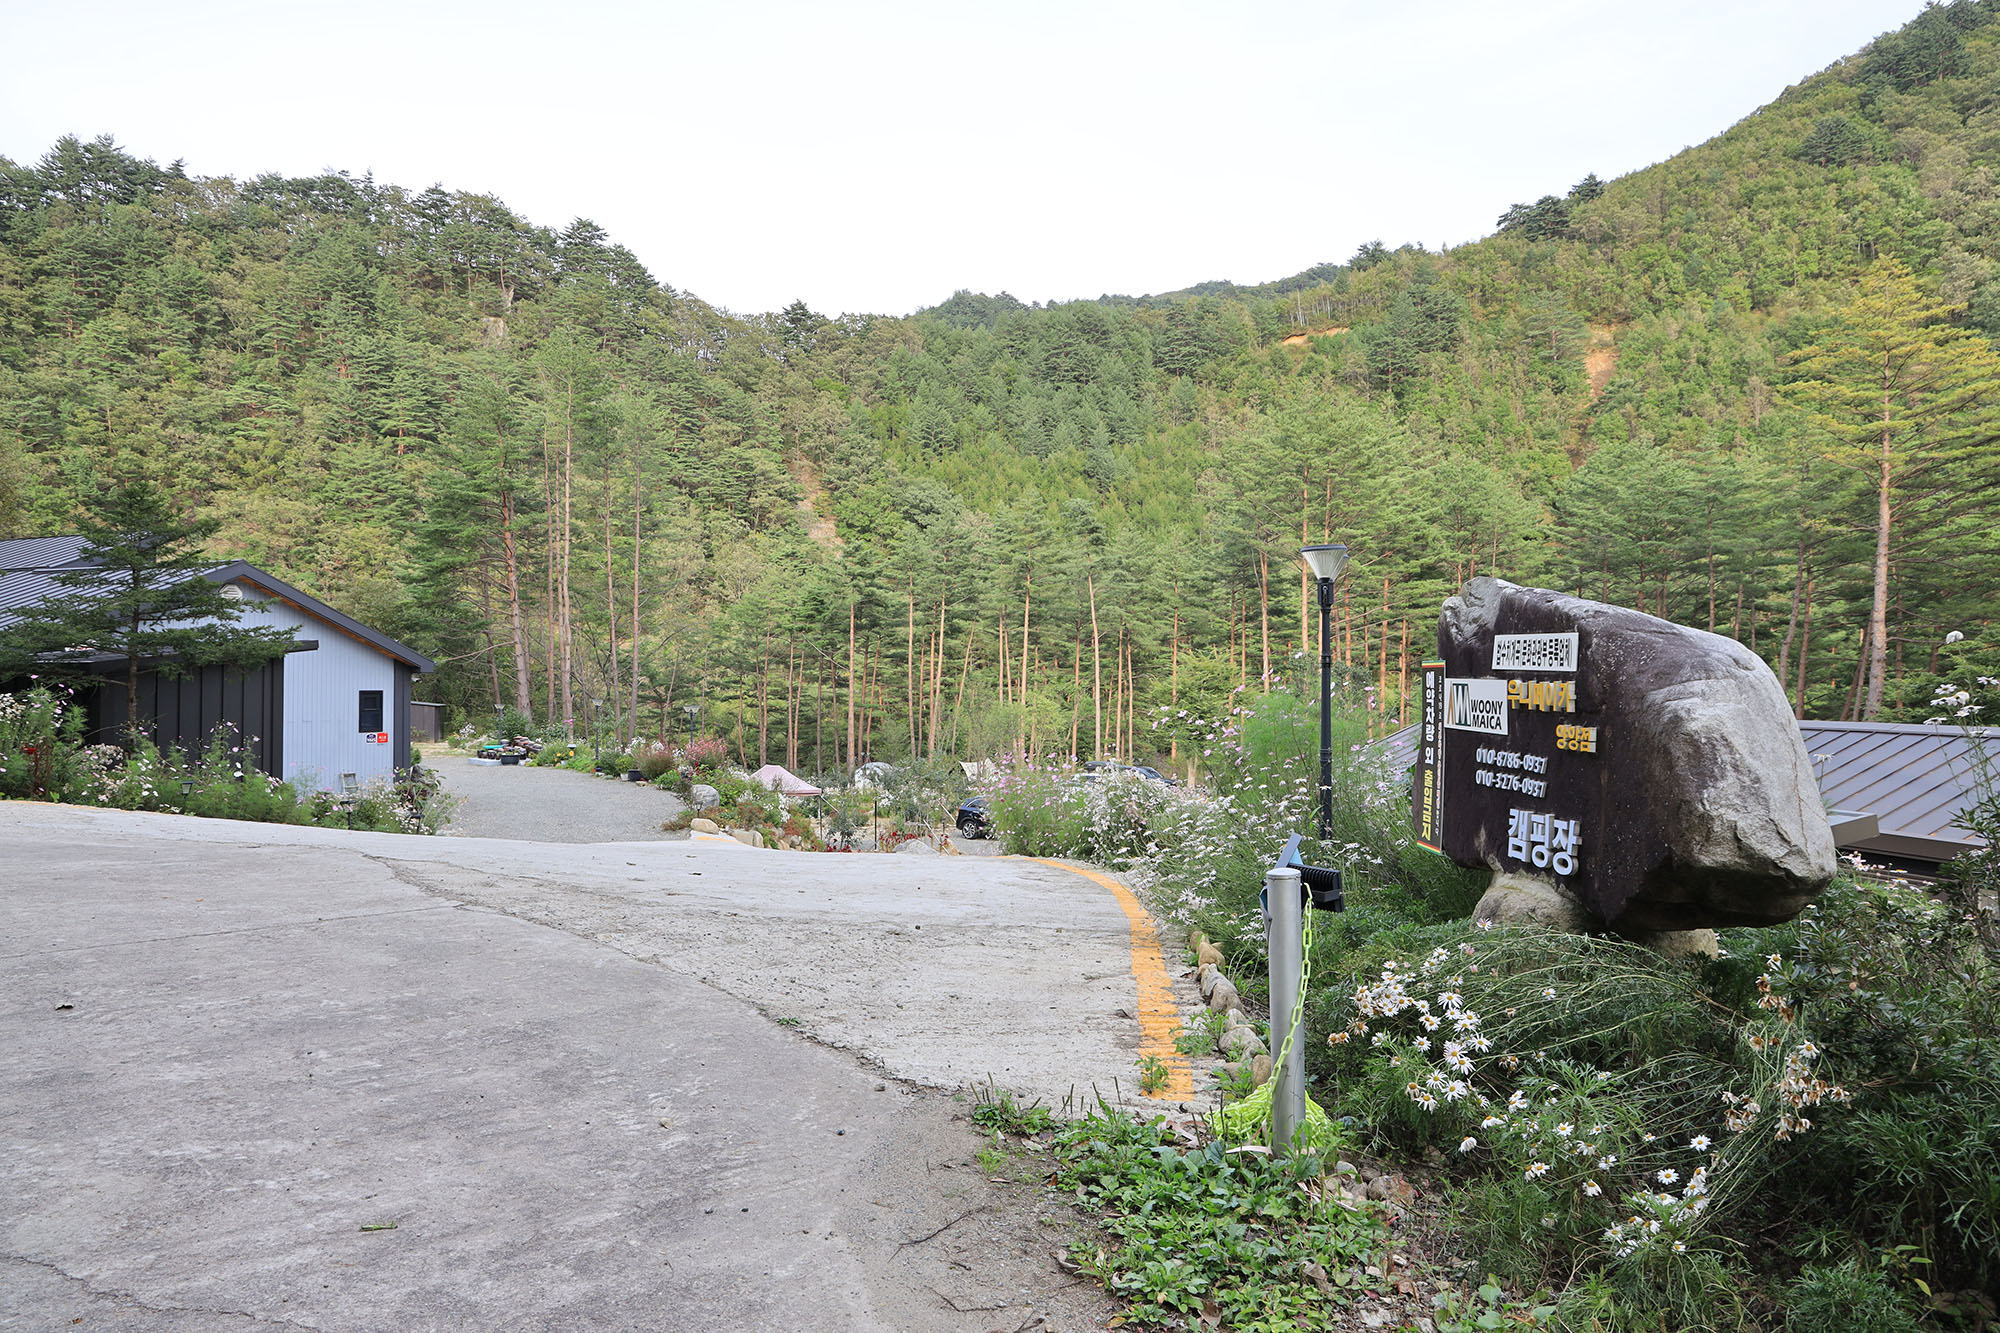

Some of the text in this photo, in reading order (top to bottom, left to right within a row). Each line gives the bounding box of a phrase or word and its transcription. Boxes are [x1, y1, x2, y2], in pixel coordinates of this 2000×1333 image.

[1471, 699, 1503, 715] WOONY
[1507, 679, 1573, 712] 우니메이카
[1472, 713, 1502, 730] MAICA
[1556, 724, 1593, 752] 양양점
[1421, 671, 1436, 841] 예약차량 외 출입금지
[1476, 747, 1547, 774] 010-8786-0937
[1475, 769, 1547, 798] 010-3276-0937
[1507, 808, 1580, 876] 캠핑장
